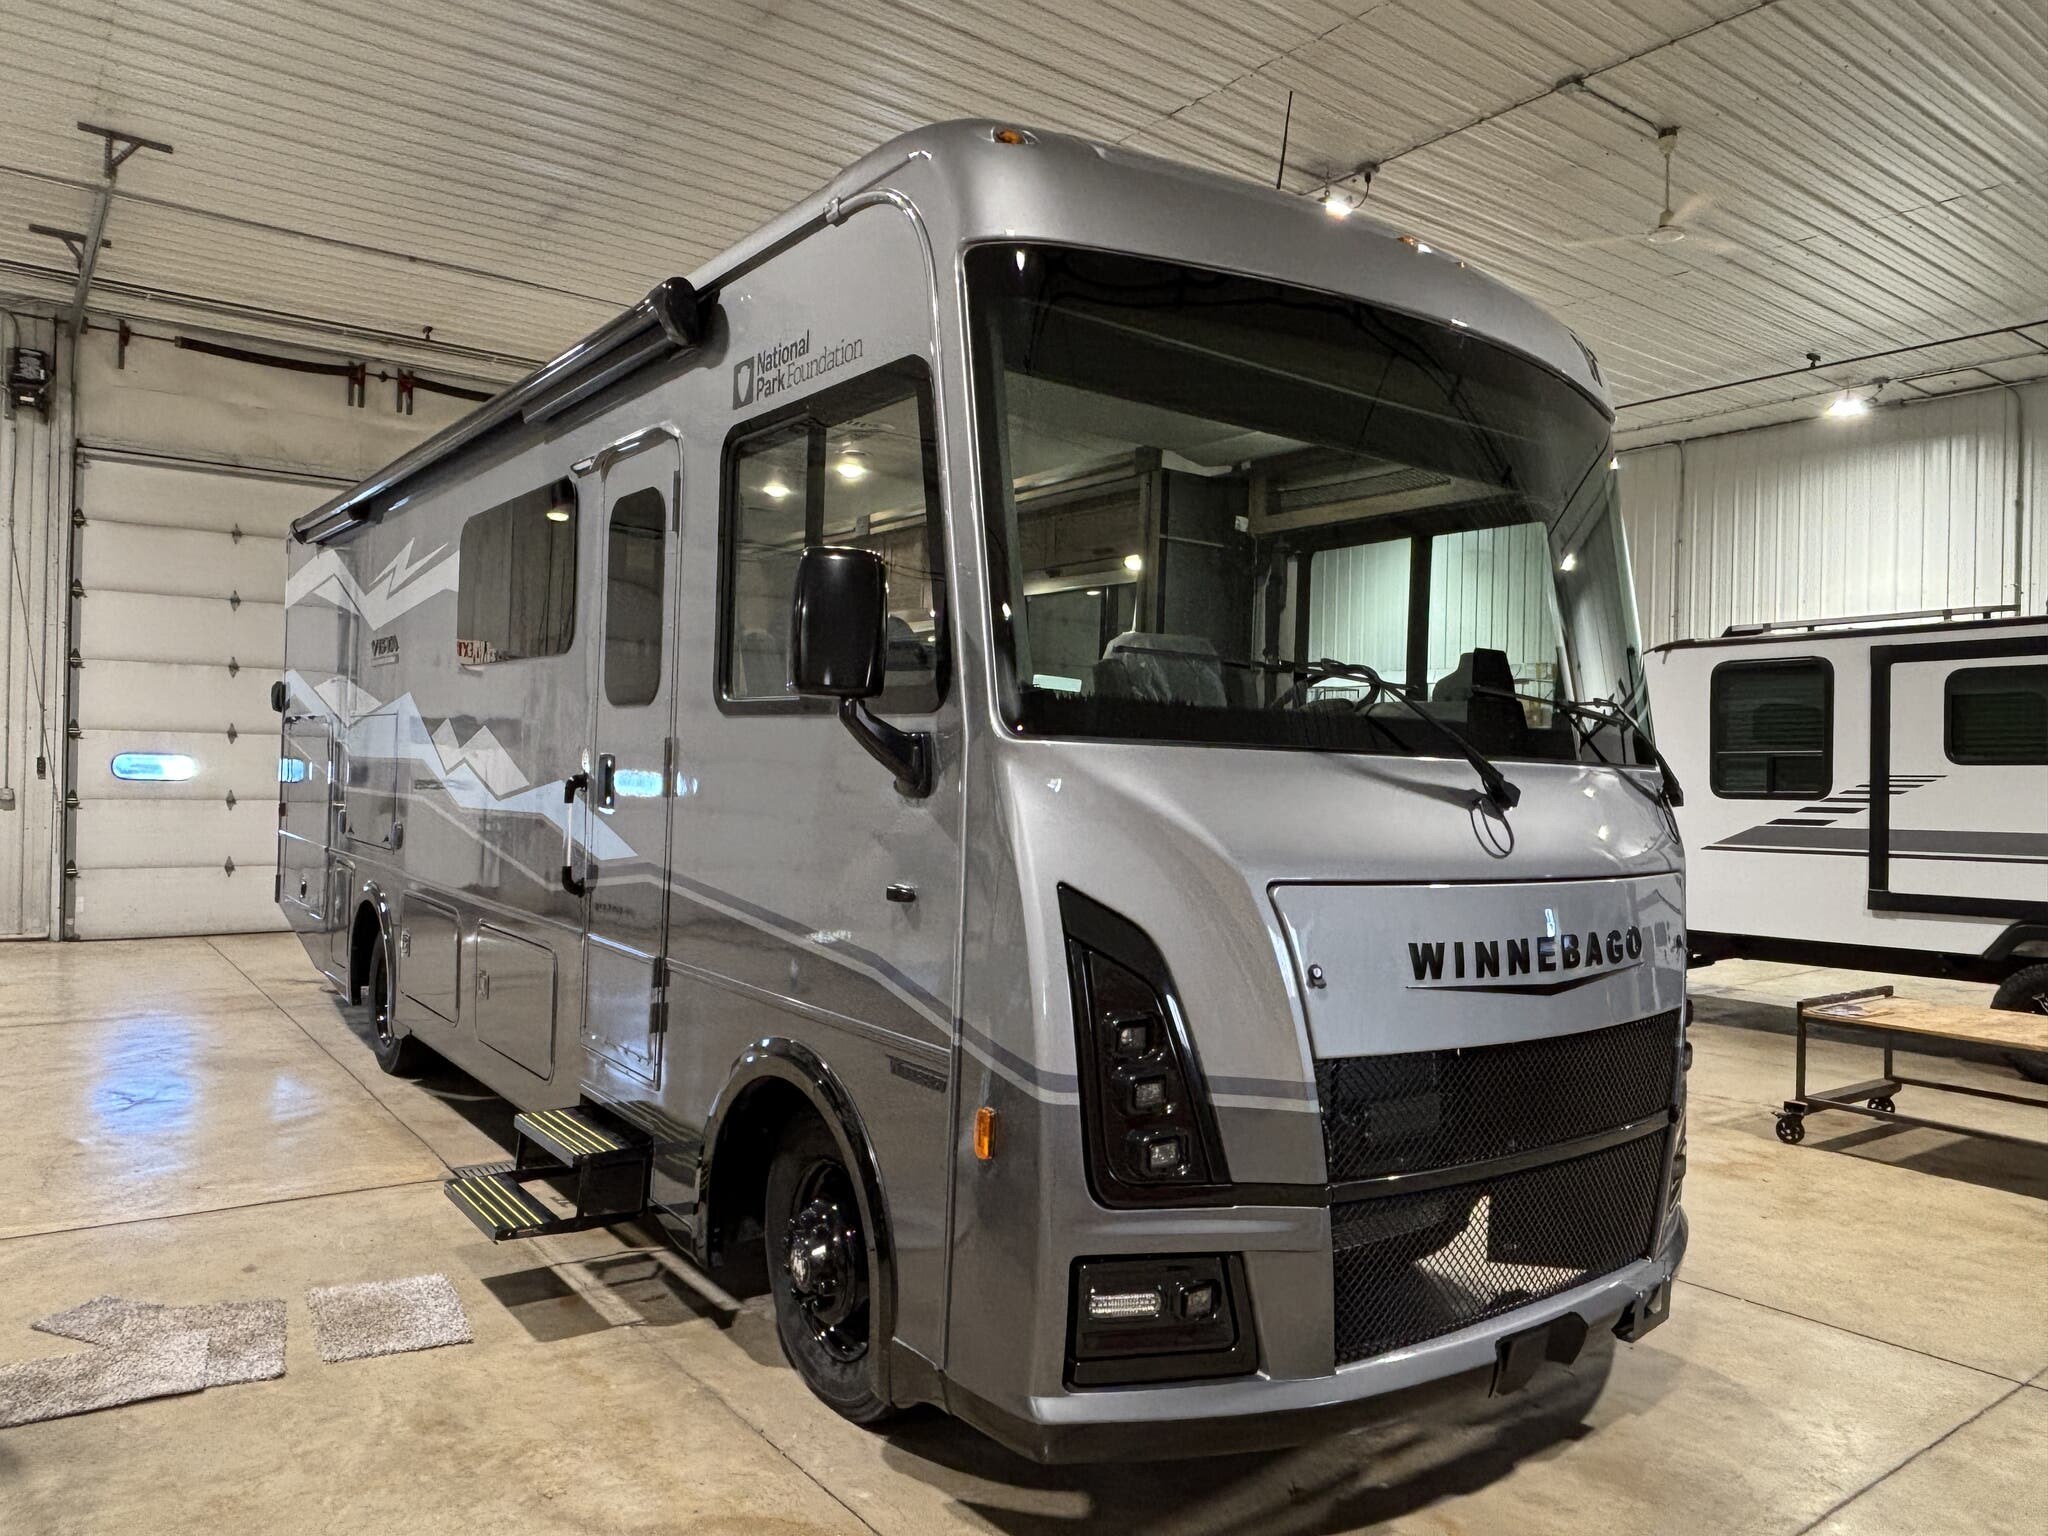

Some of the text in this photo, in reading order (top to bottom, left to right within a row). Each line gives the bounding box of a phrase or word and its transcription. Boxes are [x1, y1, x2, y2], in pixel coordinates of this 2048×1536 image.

[756, 338, 863, 401] Park Foundation
[757, 328, 810, 376] National
[1407, 925, 1642, 981] WINNEBAGO
